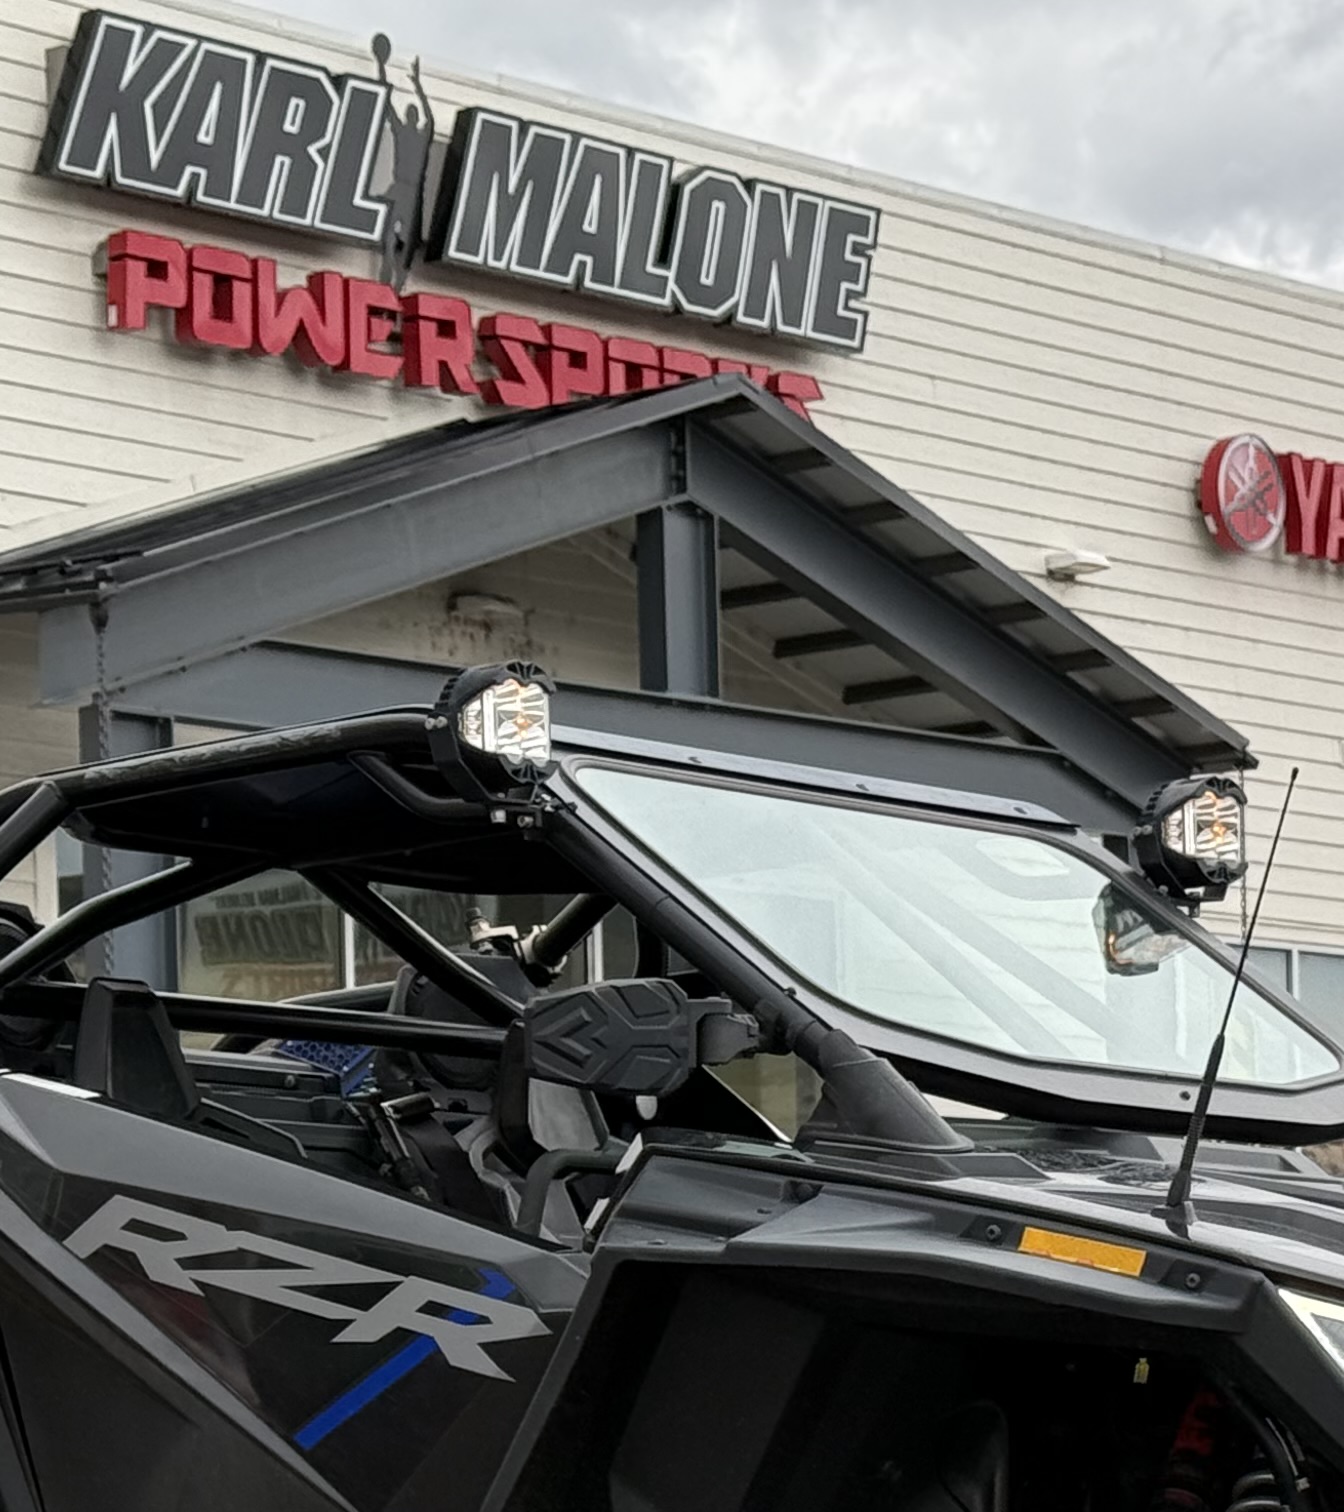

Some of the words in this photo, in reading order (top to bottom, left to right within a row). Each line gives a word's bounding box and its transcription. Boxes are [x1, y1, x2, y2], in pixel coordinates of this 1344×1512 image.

[54, 12, 392, 244] KARL
[446, 108, 881, 352] MALONE
[106, 228, 824, 424] POWERSPOS
[61, 1194, 554, 1383] RZR
